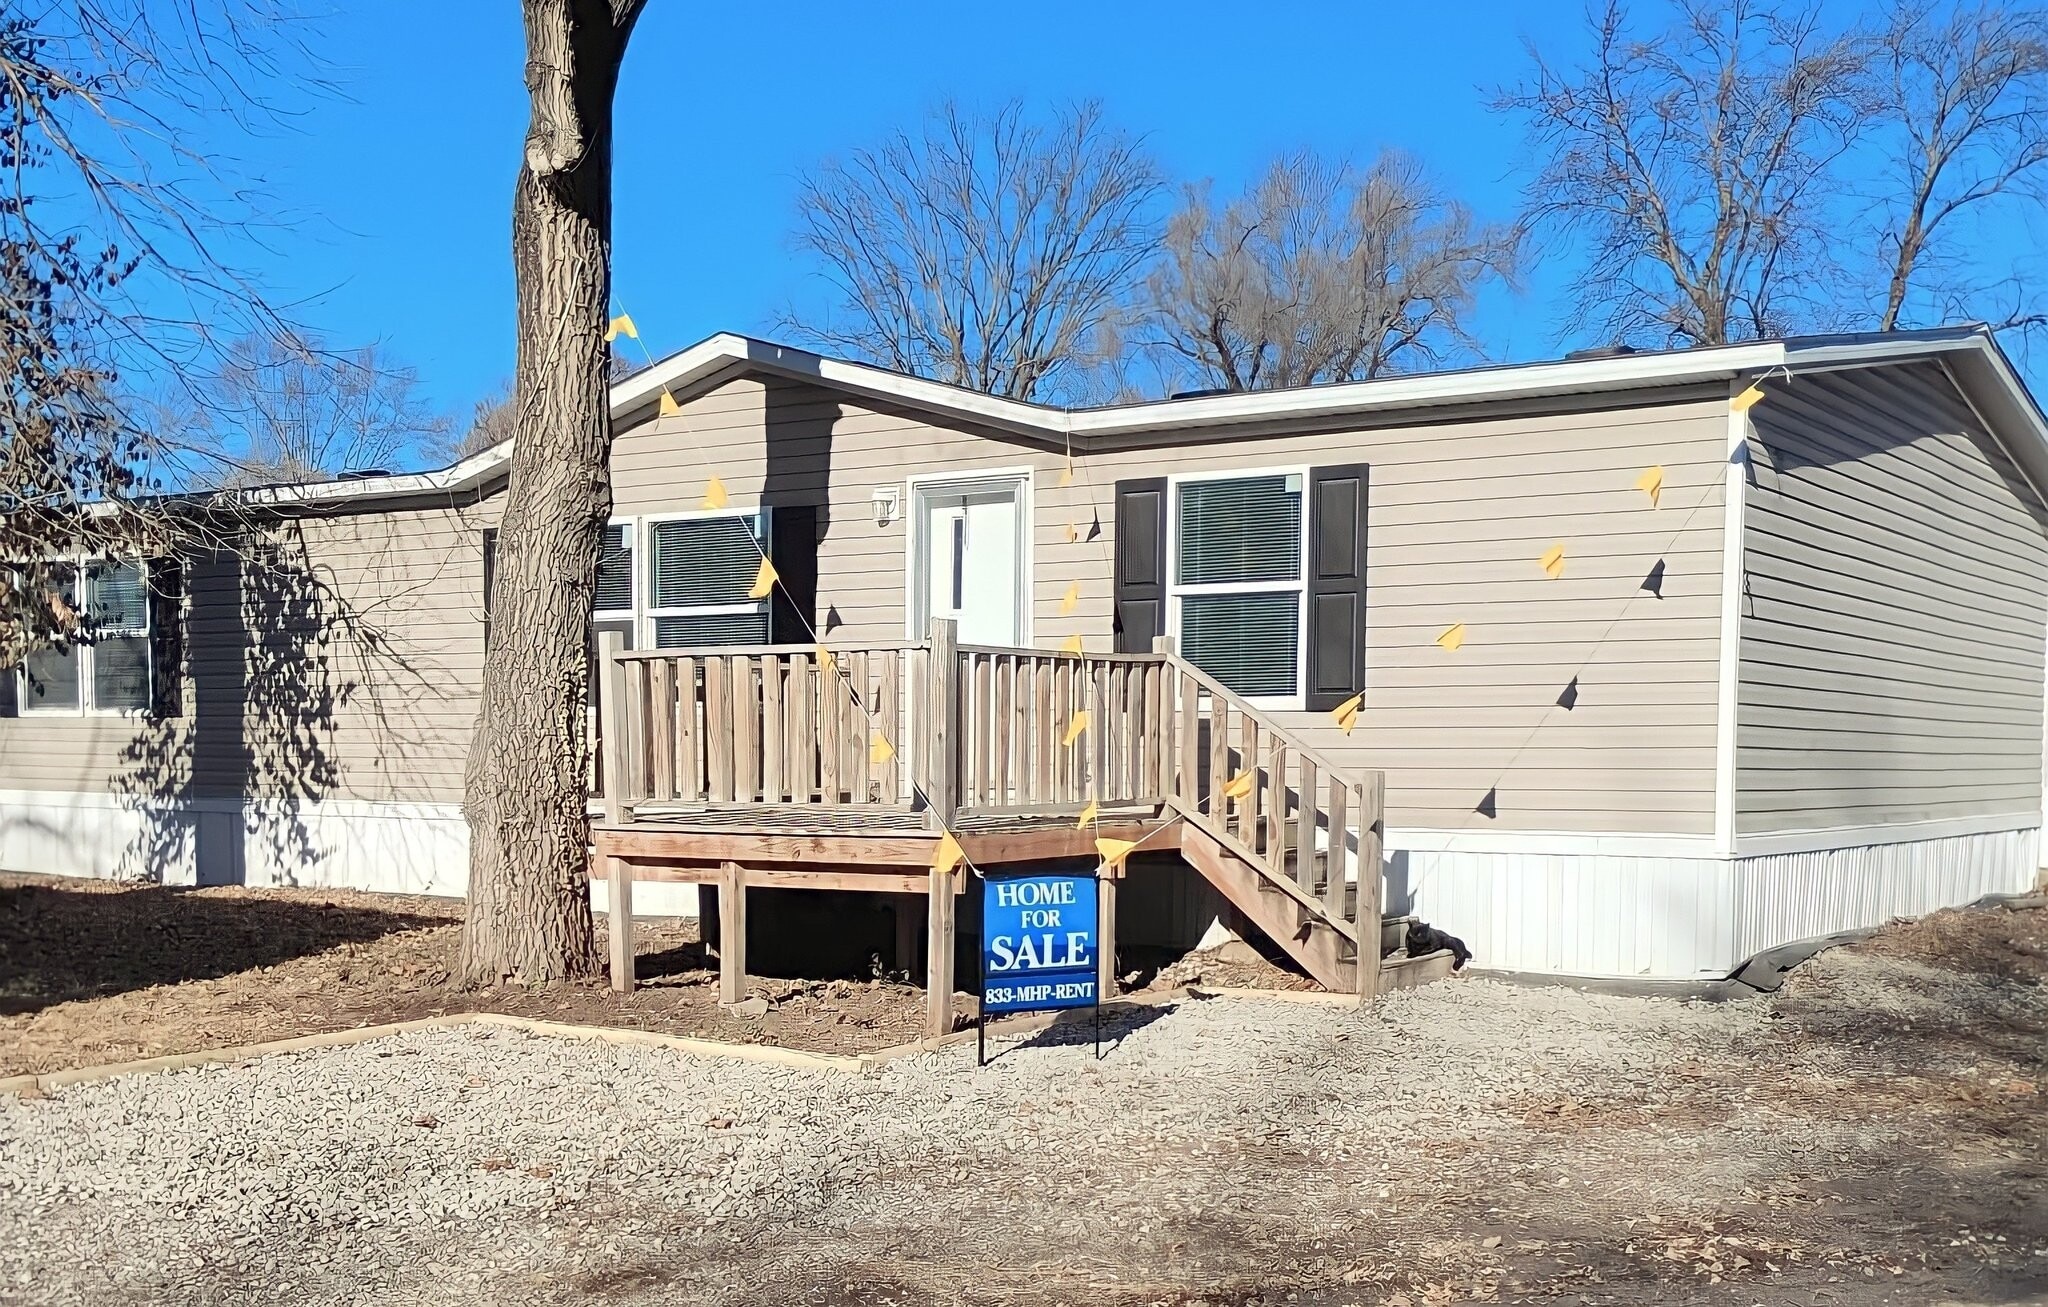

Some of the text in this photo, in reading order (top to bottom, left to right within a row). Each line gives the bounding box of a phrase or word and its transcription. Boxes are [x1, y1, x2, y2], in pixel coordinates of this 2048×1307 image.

[996, 881, 1076, 907] HOME
[1021, 909, 1062, 929] FOR
[989, 931, 1090, 972] SALE
[985, 982, 1095, 1005] 833-MHP-RENT
